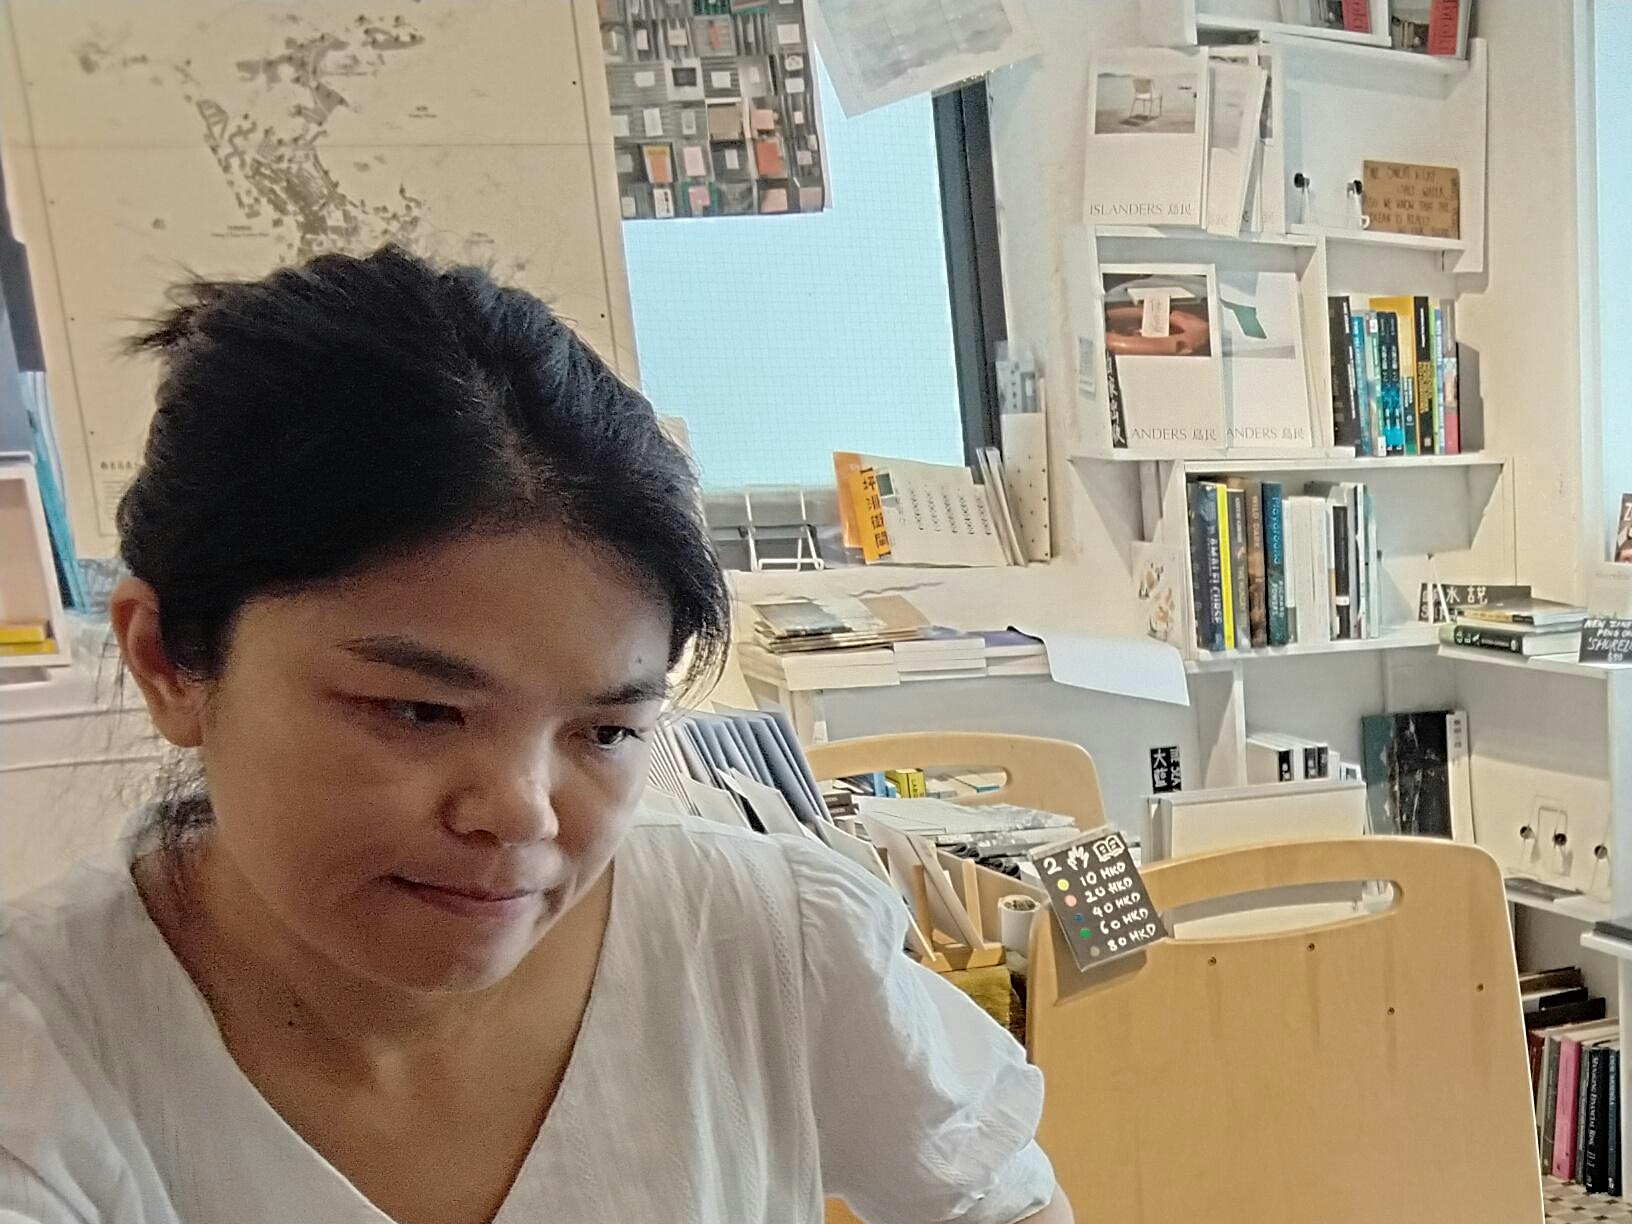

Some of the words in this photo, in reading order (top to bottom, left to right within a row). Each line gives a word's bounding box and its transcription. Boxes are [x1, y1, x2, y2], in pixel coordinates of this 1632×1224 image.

[1089, 202, 1162, 216] ISLANDERS
[1043, 857, 1062, 875] 2
[1080, 871, 1097, 887] 10
[1100, 861, 1126, 880] HKD
[1084, 886, 1106, 903] 20
[1108, 877, 1133, 895] HKD
[1092, 902, 1114, 918] 40
[1115, 892, 1141, 910] HKD
[1100, 920, 1121, 935] 60
[1122, 908, 1149, 925] HKD
[1107, 936, 1127, 951] 80
[1129, 923, 1156, 942] HKD
